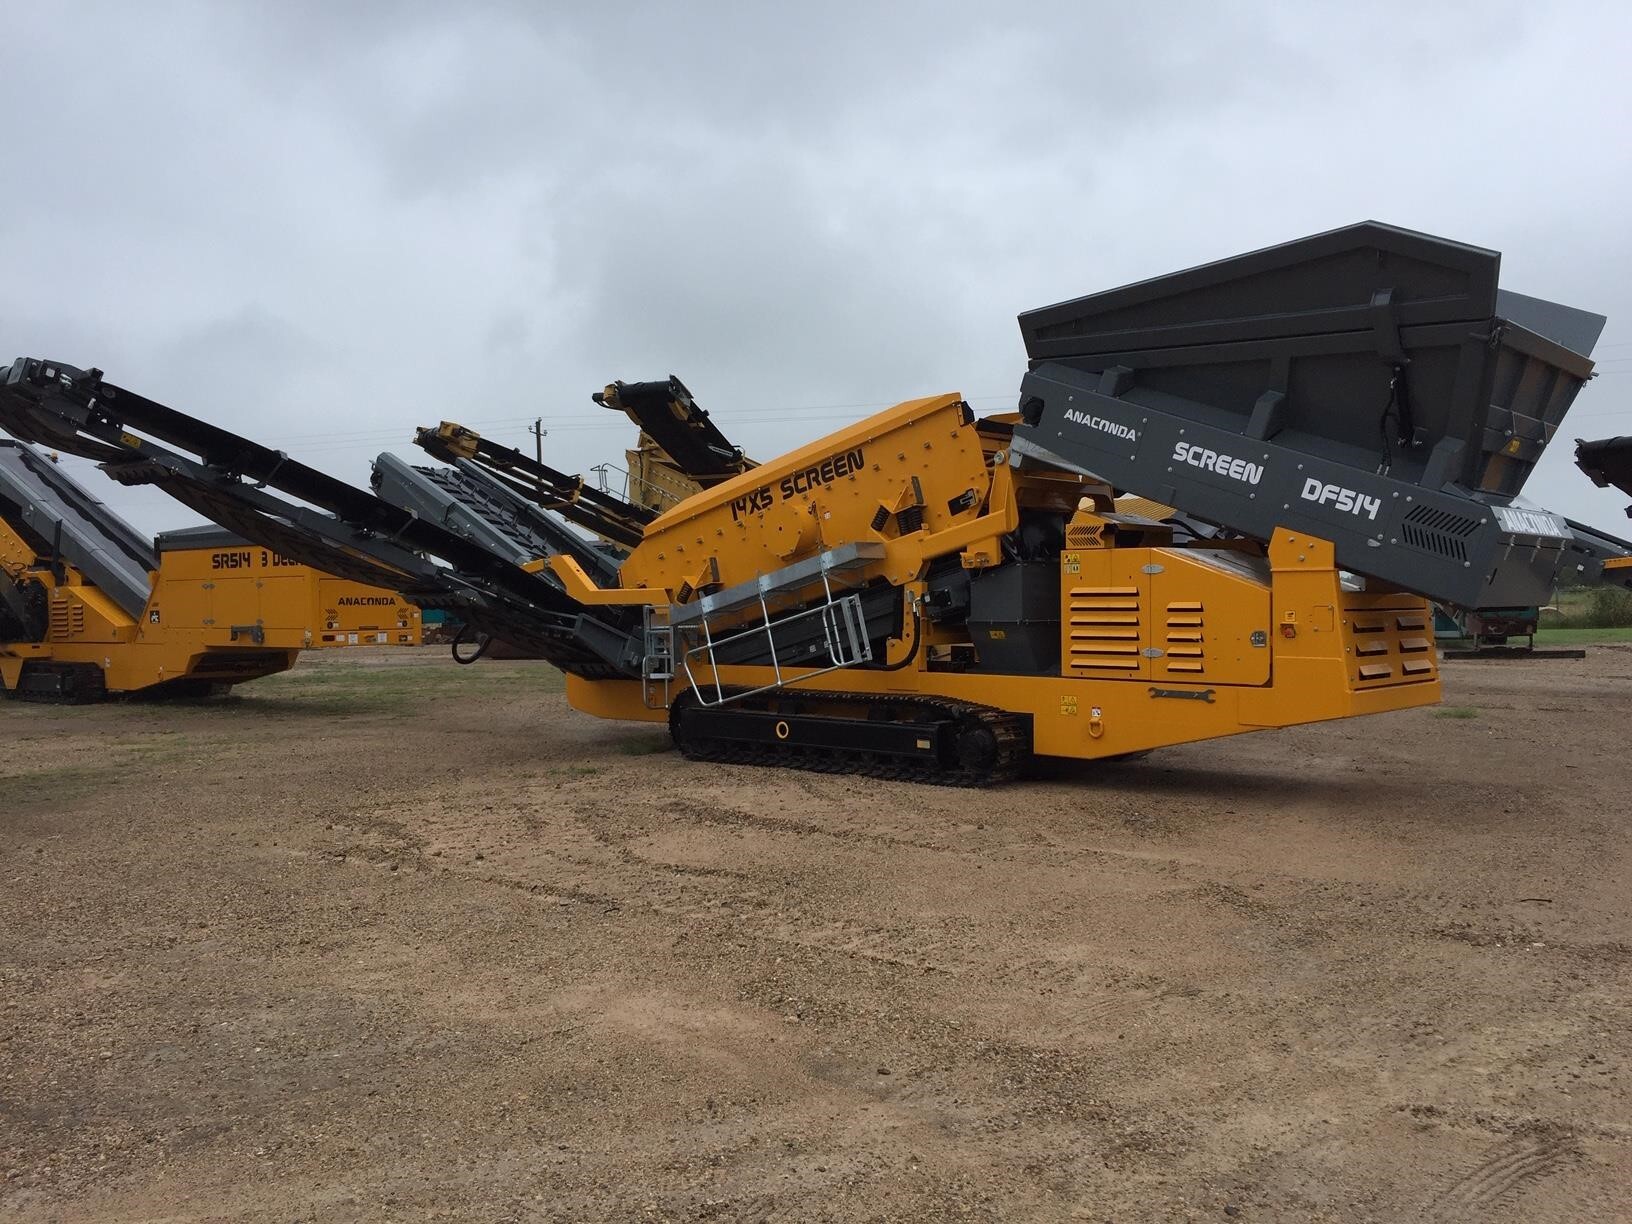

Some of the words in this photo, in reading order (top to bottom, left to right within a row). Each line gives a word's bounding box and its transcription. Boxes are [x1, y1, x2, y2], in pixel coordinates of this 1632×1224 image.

[1064, 408, 1136, 442] ANACONDA
[1172, 441, 1264, 485] SCREEN
[731, 487, 774, 521] 14X5
[780, 448, 865, 500] SCREEN
[1301, 477, 1381, 521] DF514
[212, 551, 251, 569] SR514
[261, 550, 268, 567] 3
[338, 597, 396, 606] ANACONDA
